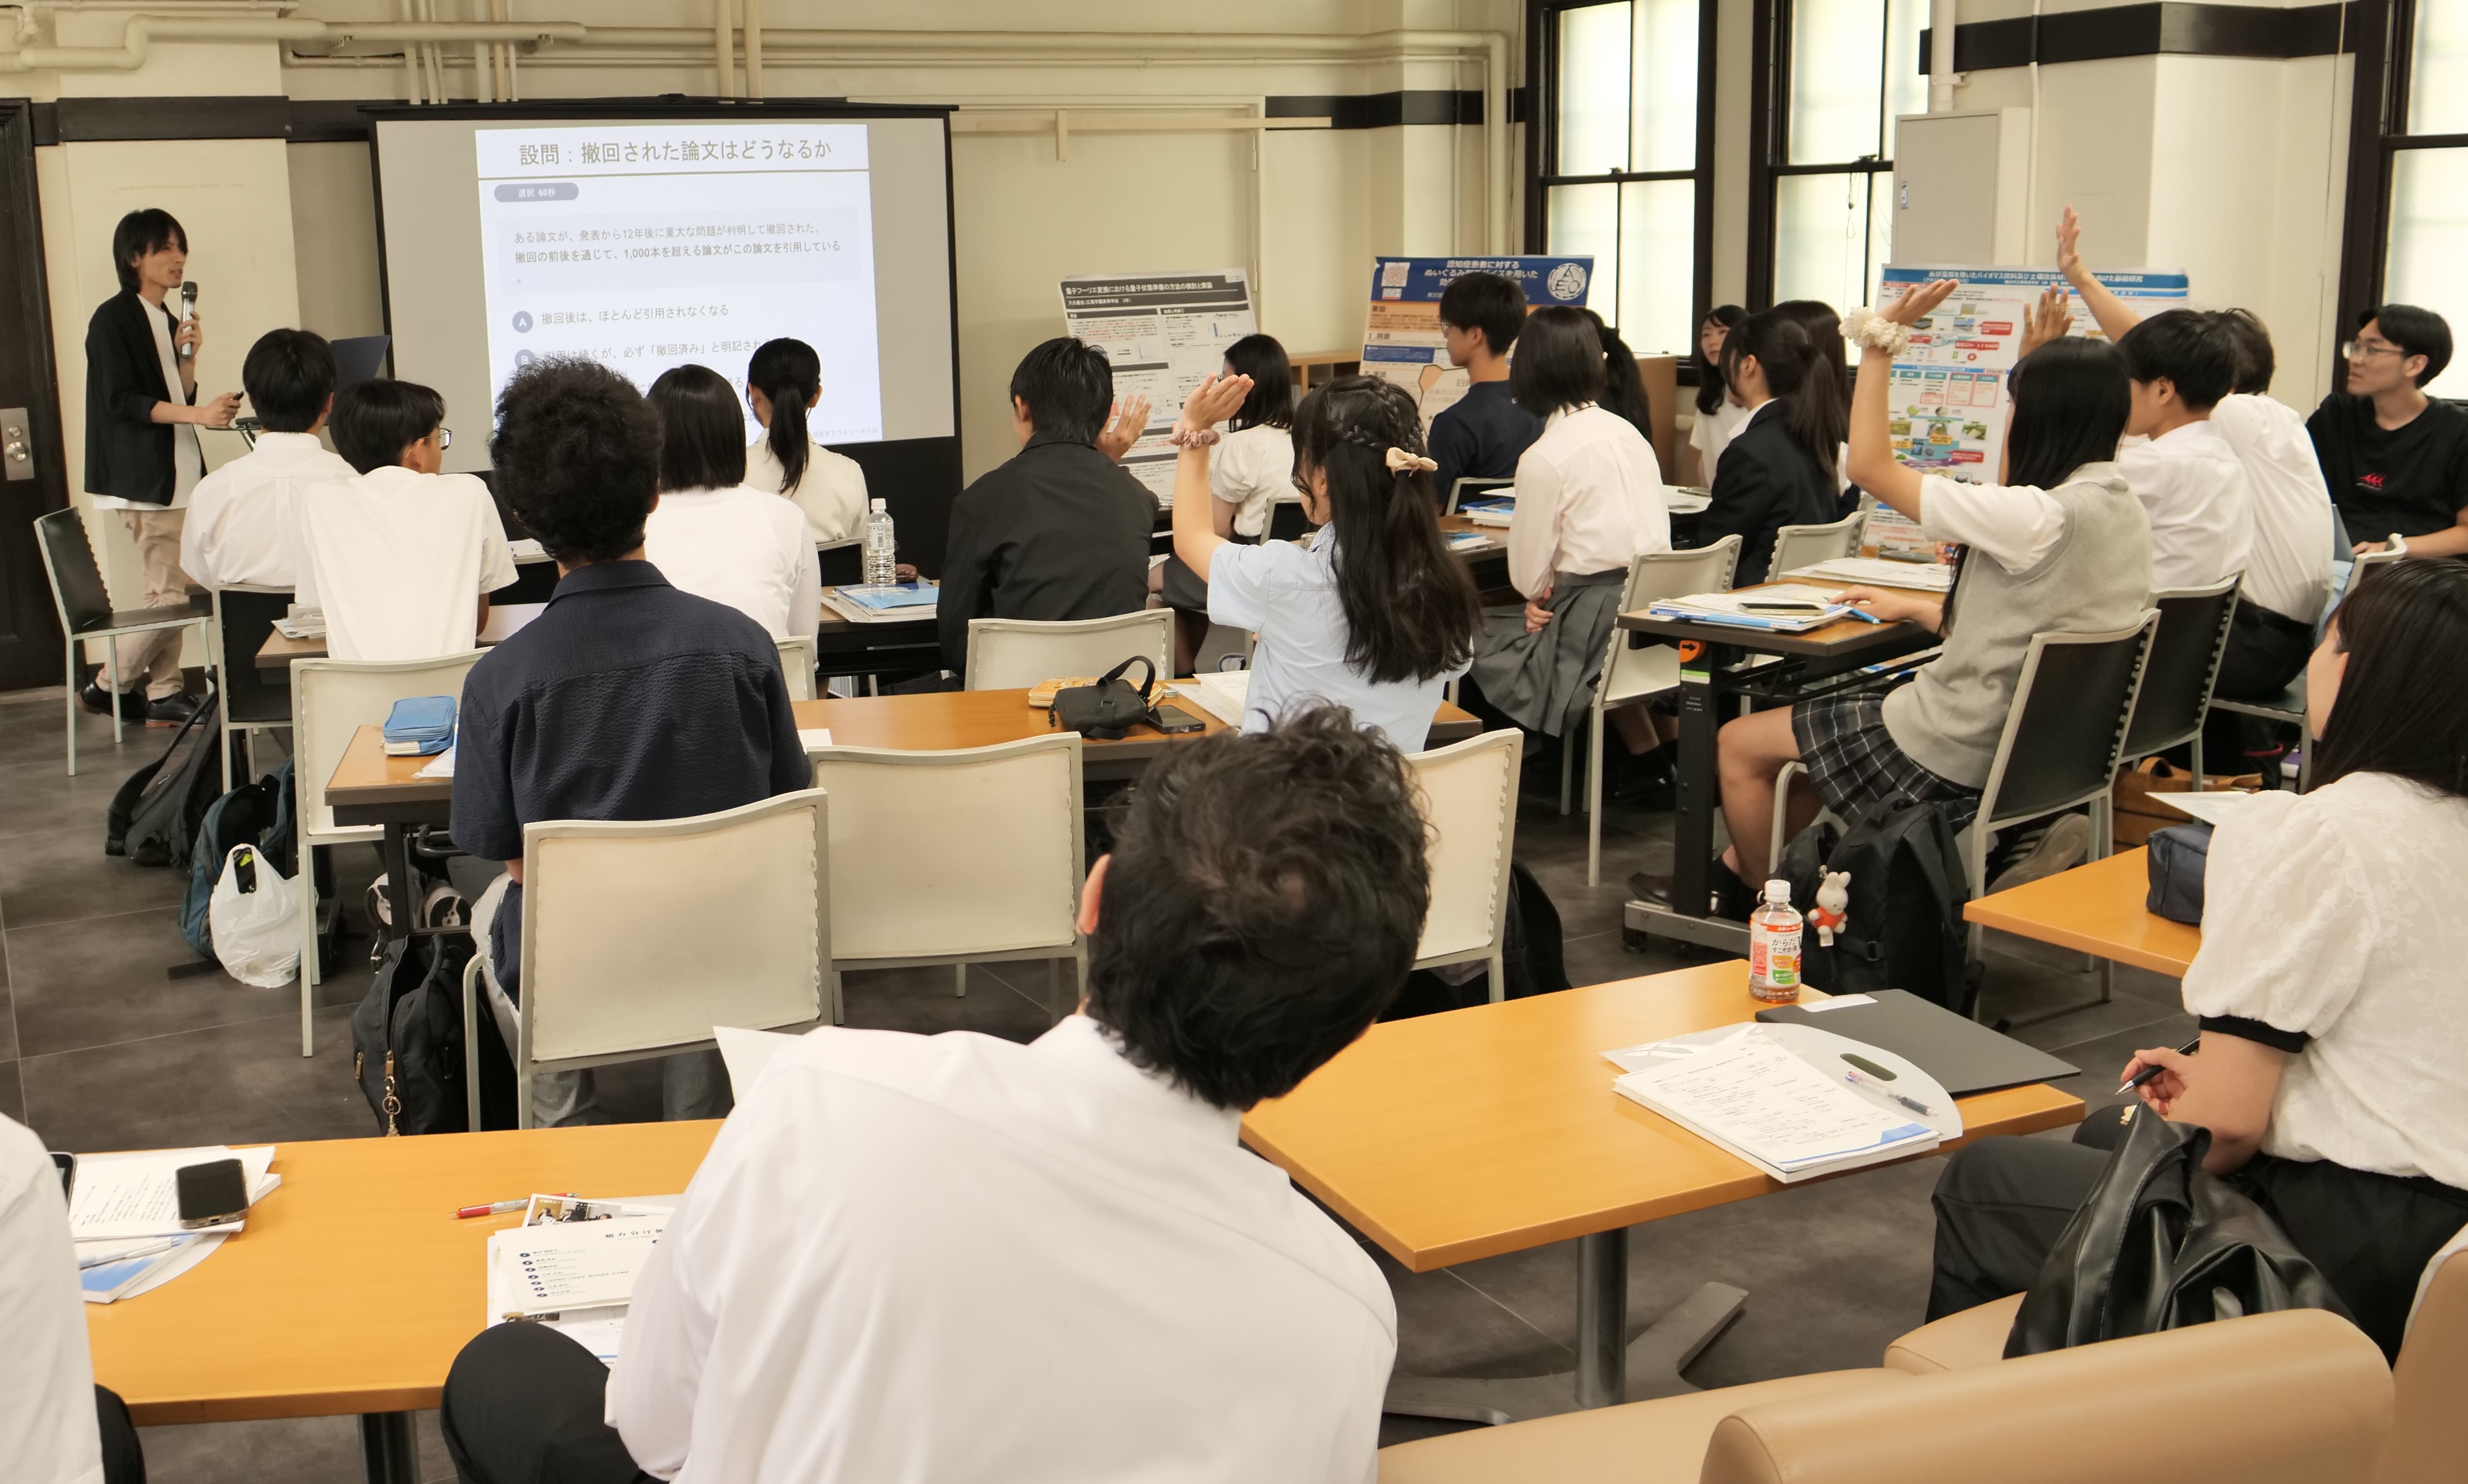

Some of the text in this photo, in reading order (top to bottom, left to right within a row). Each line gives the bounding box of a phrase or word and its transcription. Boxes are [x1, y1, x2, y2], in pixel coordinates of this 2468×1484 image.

[520, 140, 832, 165] 設問：撤回された論文はどうなるか
[539, 187, 556, 197] 60秒
[541, 304, 729, 325] 撤回後は、ほとんど引用されなくなる
[520, 318, 527, 327] A
